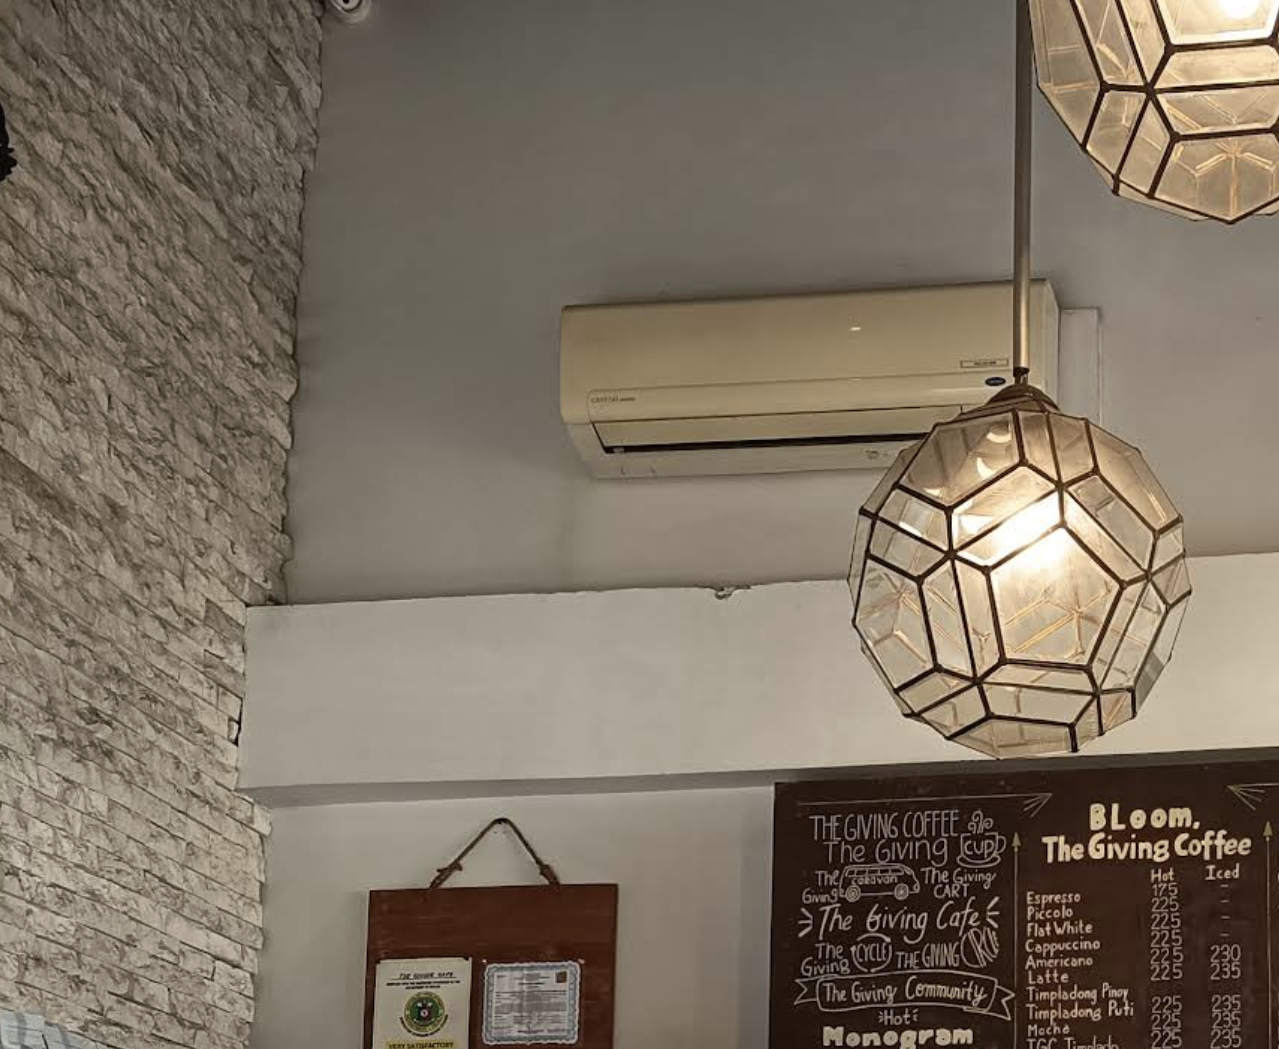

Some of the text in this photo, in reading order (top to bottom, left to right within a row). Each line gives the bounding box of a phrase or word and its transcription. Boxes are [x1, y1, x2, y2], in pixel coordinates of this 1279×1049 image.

[809, 810, 960, 841] THE GIVING COFFEE
[823, 840, 865, 863] The
[875, 838, 947, 867] Giving
[1041, 830, 1251, 863] The Giving Coffee
[815, 870, 839, 886] The
[1151, 863, 1240, 882] Hot Iced
[921, 868, 996, 898] The Giving CART
[802, 888, 838, 904] Giving
[1026, 891, 1081, 908] Espresso
[819, 897, 980, 943] The Giving Cafe
[1027, 906, 1073, 921] Piccolo
[1027, 920, 1092, 937] Flat White
[896, 952, 920, 969] THE
[922, 943, 959, 967] GIVING
[1025, 936, 1100, 956] Cappuccino
[801, 943, 888, 977] The Giving CYCLE
[1026, 955, 1093, 970] Americano
[1028, 971, 1069, 985] Latte
[823, 976, 987, 1006] The Giving Community
[1026, 983, 1128, 1005] Timpladong Pinoy
[884, 1010, 910, 1025] Hot
[1026, 1001, 1134, 1025] Timpladong Puti
[1027, 1024, 1070, 1037] Mocha
